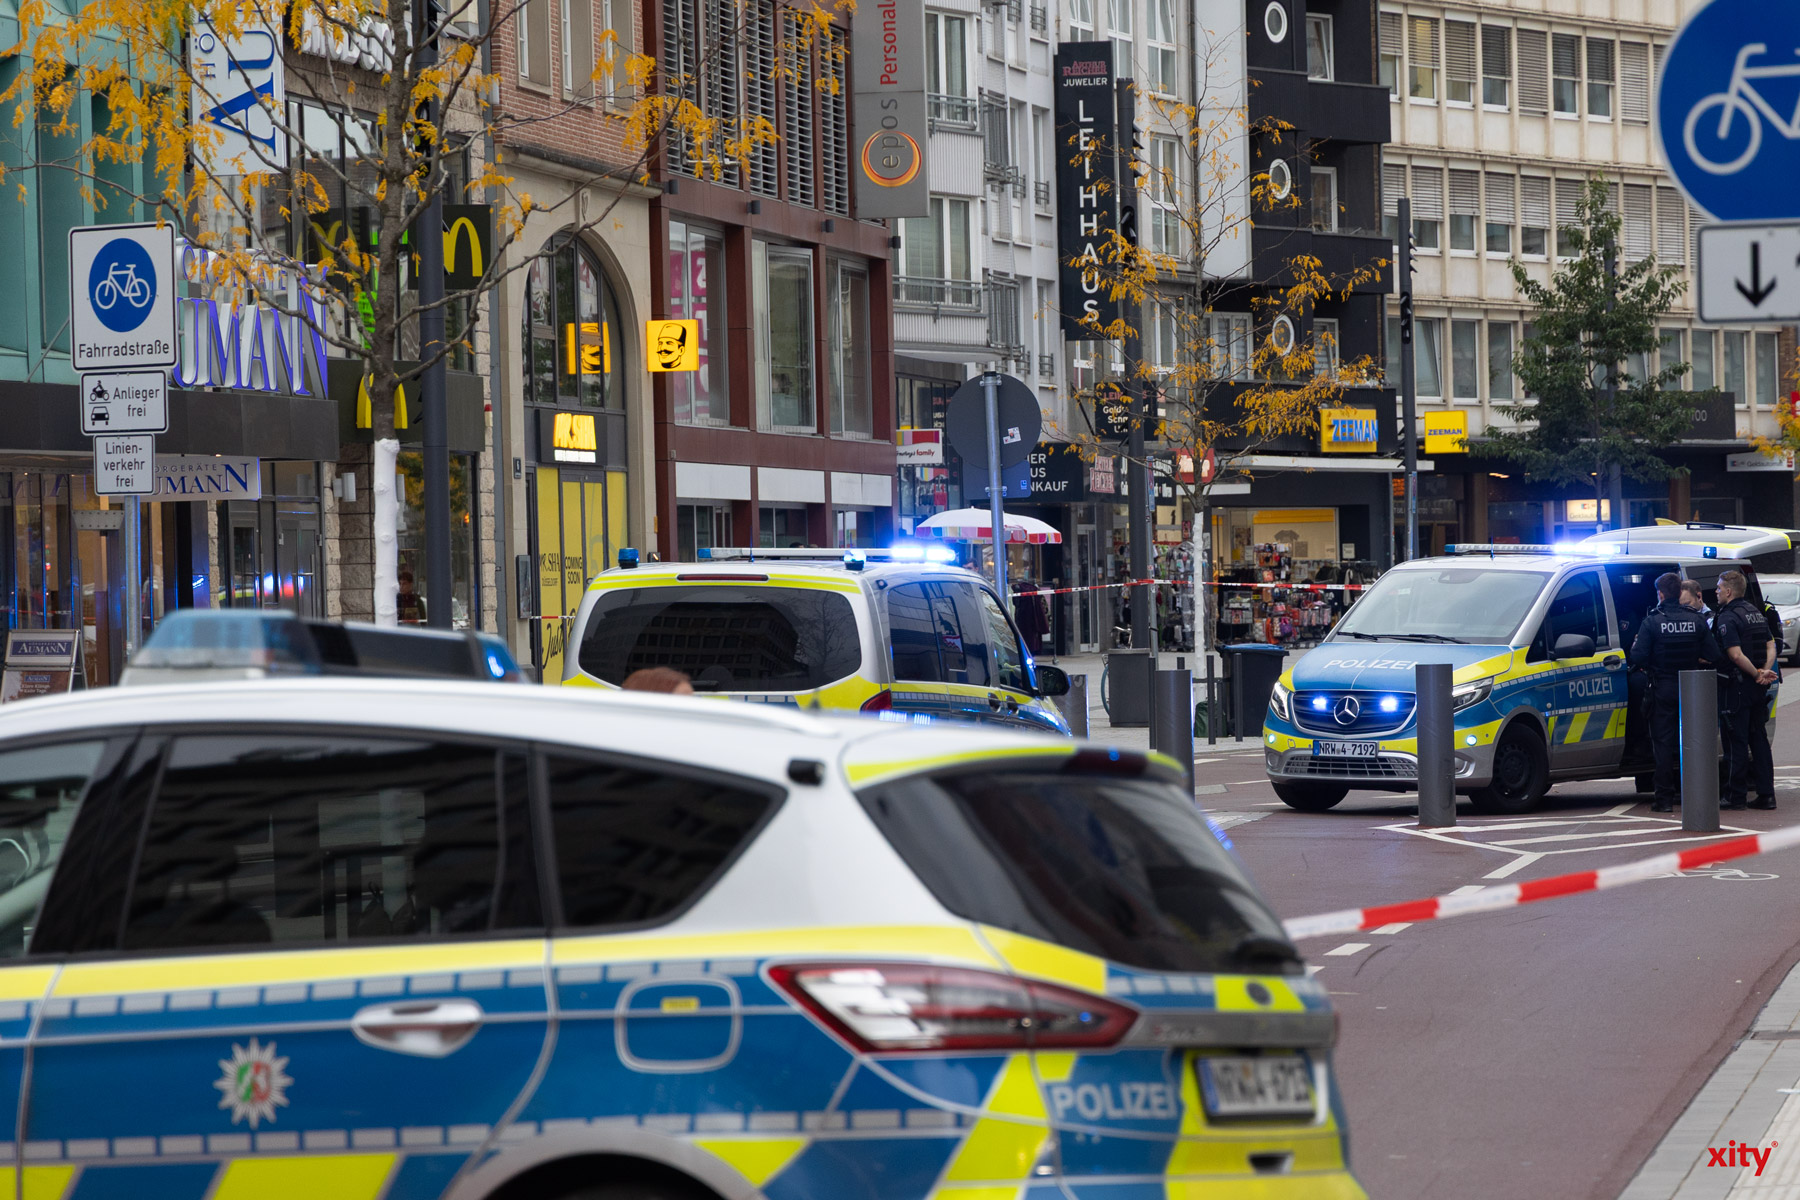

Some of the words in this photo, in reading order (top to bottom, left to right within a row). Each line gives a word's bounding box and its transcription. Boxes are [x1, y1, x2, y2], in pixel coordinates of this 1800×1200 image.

[877, 0, 898, 85] Personal
[1063, 77, 1108, 87] JUWELIER
[881, 98, 907, 169] epos
[1078, 100, 1099, 322] LEIHHAUS
[168, 261, 329, 400] UMANN
[79, 340, 170, 358] Fahrradstraße
[113, 386, 160, 402] Anlieger
[127, 404, 146, 417] frei
[1332, 419, 1378, 442] ZEEMAN
[1428, 428, 1462, 436] ZEEMAN
[105, 442, 143, 455] Linien-
[917, 449, 935, 457] family
[103, 458, 146, 471] verkehr
[116, 475, 134, 488] frei
[565, 556, 583, 570] COMING
[567, 571, 581, 584] SOON
[1661, 622, 1696, 633] POLIZEI
[18, 642, 68, 653] AUMANN
[1323, 659, 1419, 670] POLIZEI
[1569, 676, 1613, 698] POLIZEI
[1320, 743, 1336, 754] NRW
[1341, 744, 1375, 756] 4-7192
[1052, 1083, 1177, 1120] POLIZEI
